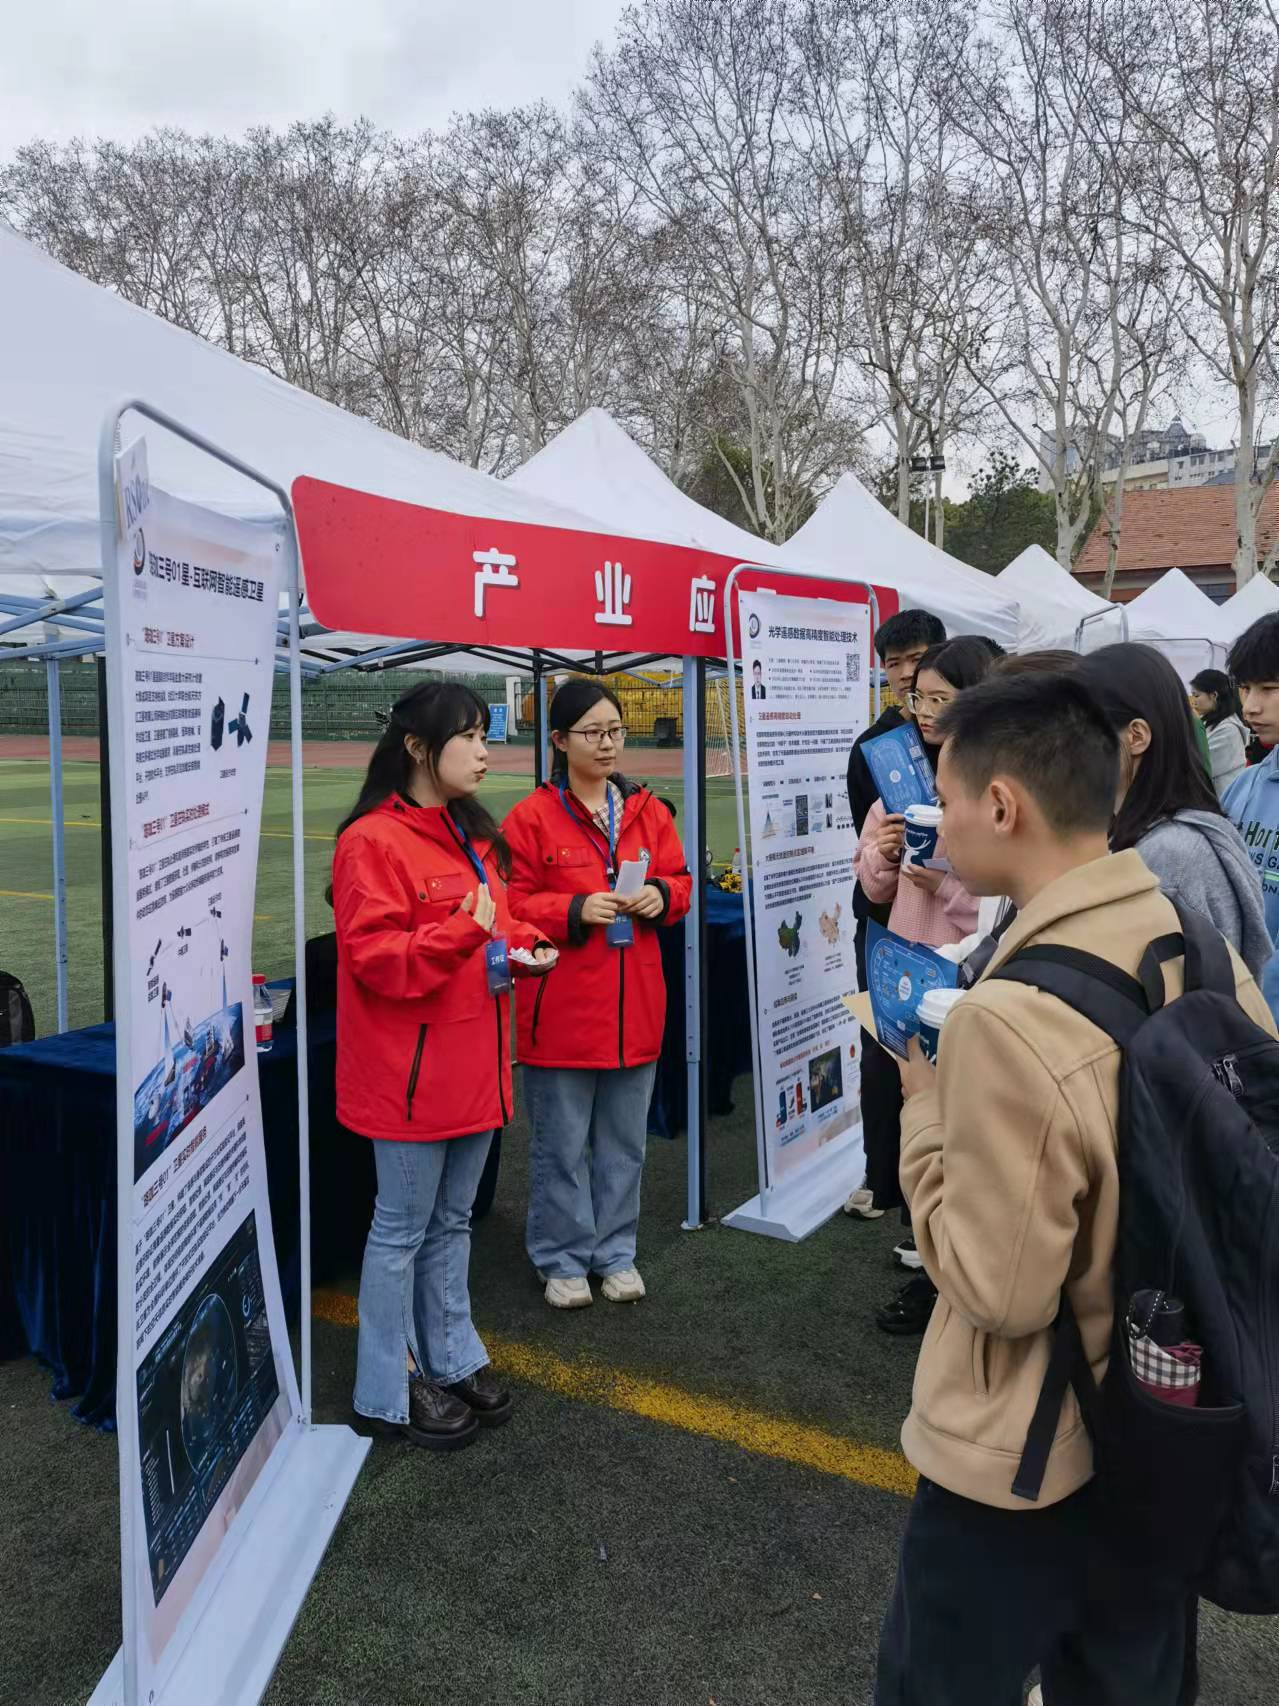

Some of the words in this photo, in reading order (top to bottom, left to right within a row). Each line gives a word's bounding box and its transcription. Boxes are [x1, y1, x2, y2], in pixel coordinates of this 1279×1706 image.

[768, 625, 858, 643] 光学遥感数据高精度智能处理技术
